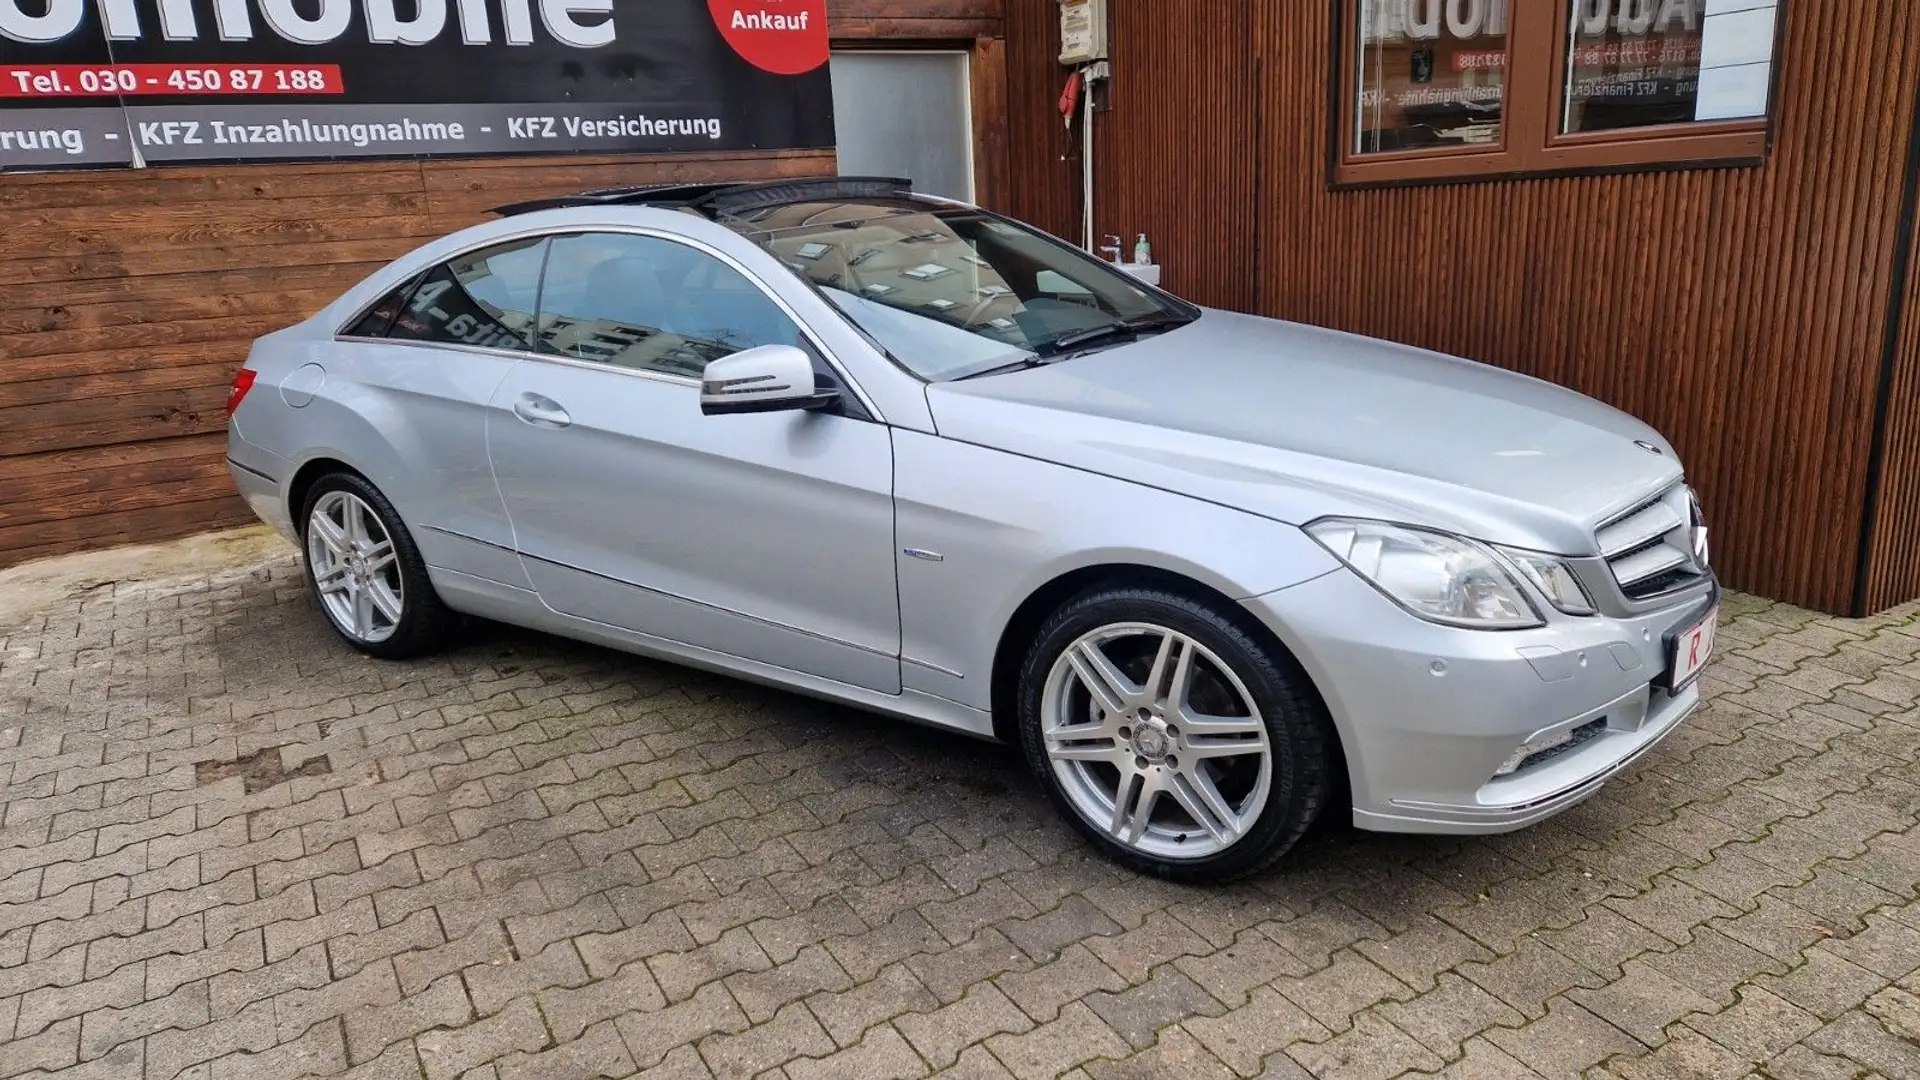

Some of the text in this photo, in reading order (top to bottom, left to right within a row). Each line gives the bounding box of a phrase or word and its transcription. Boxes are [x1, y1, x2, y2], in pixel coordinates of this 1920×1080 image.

[731, 9, 809, 30] Ankauf
[11, 70, 71, 92] Tel.
[80, 69, 137, 92] 030
[168, 69, 222, 91] 450
[229, 69, 263, 90] 87
[275, 69, 325, 90] 188
[138, 121, 203, 146] KFZ
[210, 117, 465, 147] Inzahlungnahme
[507, 116, 558, 139] KFZ
[563, 115, 721, 139] Versicherung
